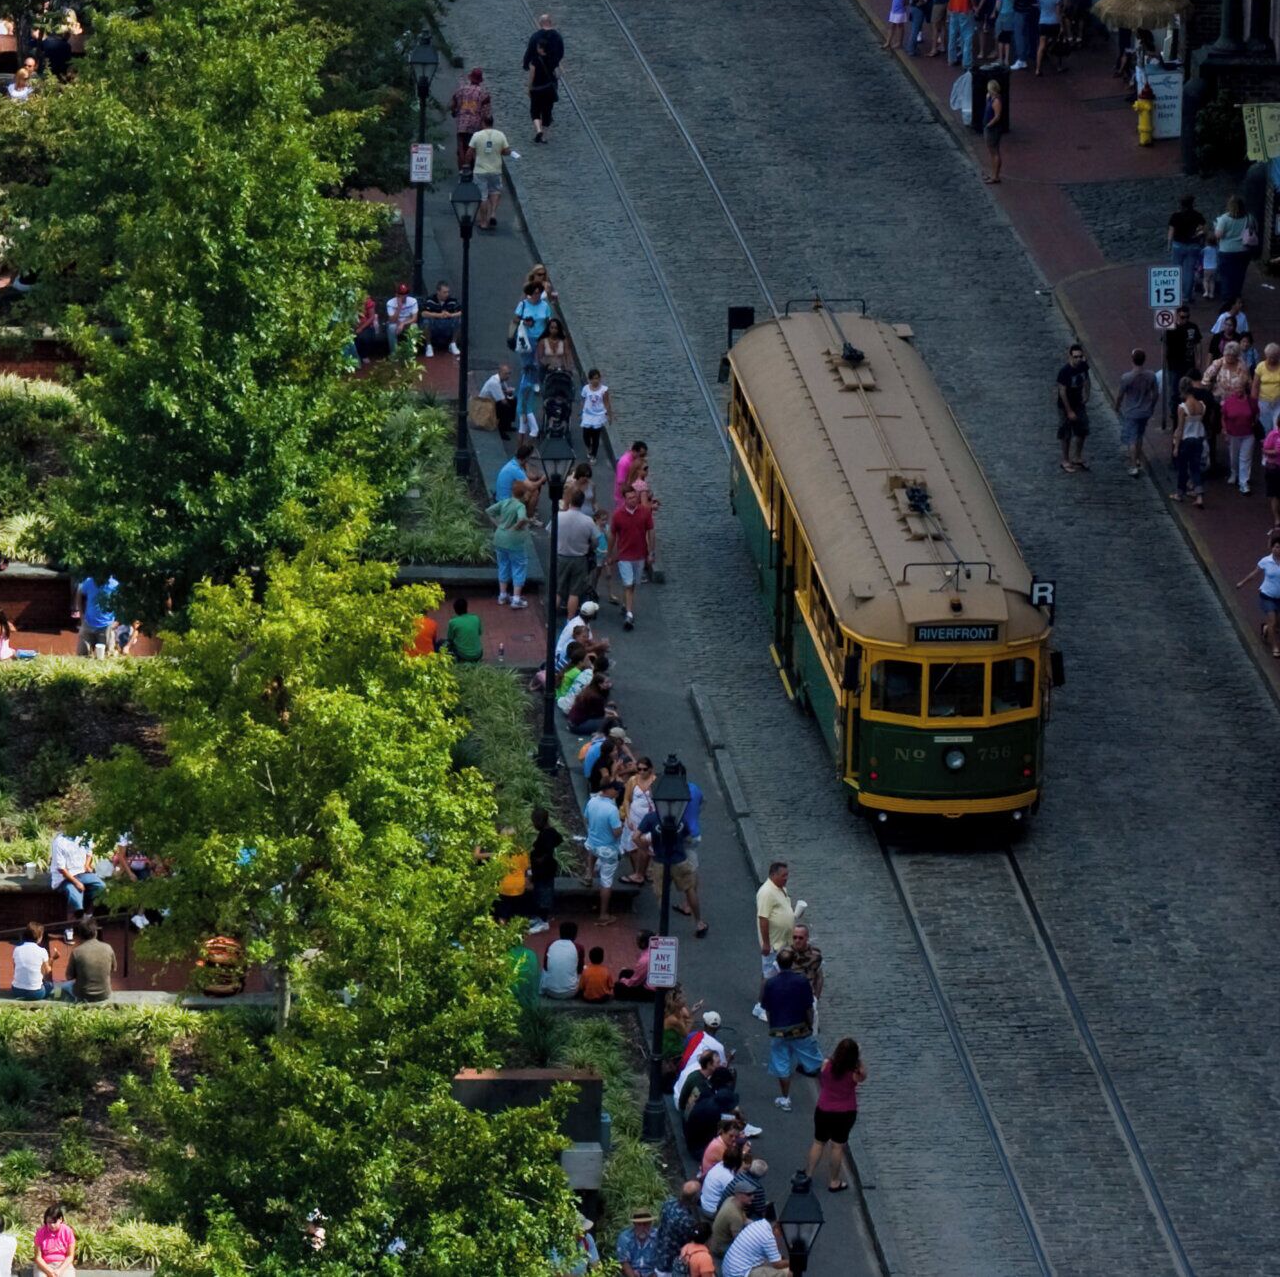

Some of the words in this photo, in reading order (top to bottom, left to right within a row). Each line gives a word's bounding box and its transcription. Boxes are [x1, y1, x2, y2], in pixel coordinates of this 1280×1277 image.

[1155, 288, 1176, 304] 15
[1032, 583, 1054, 605] R
[918, 627, 994, 640] RIVERFRONT
[977, 747, 1012, 761] 756
[655, 954, 670, 962] ANY
[654, 963, 671, 972] TIME
